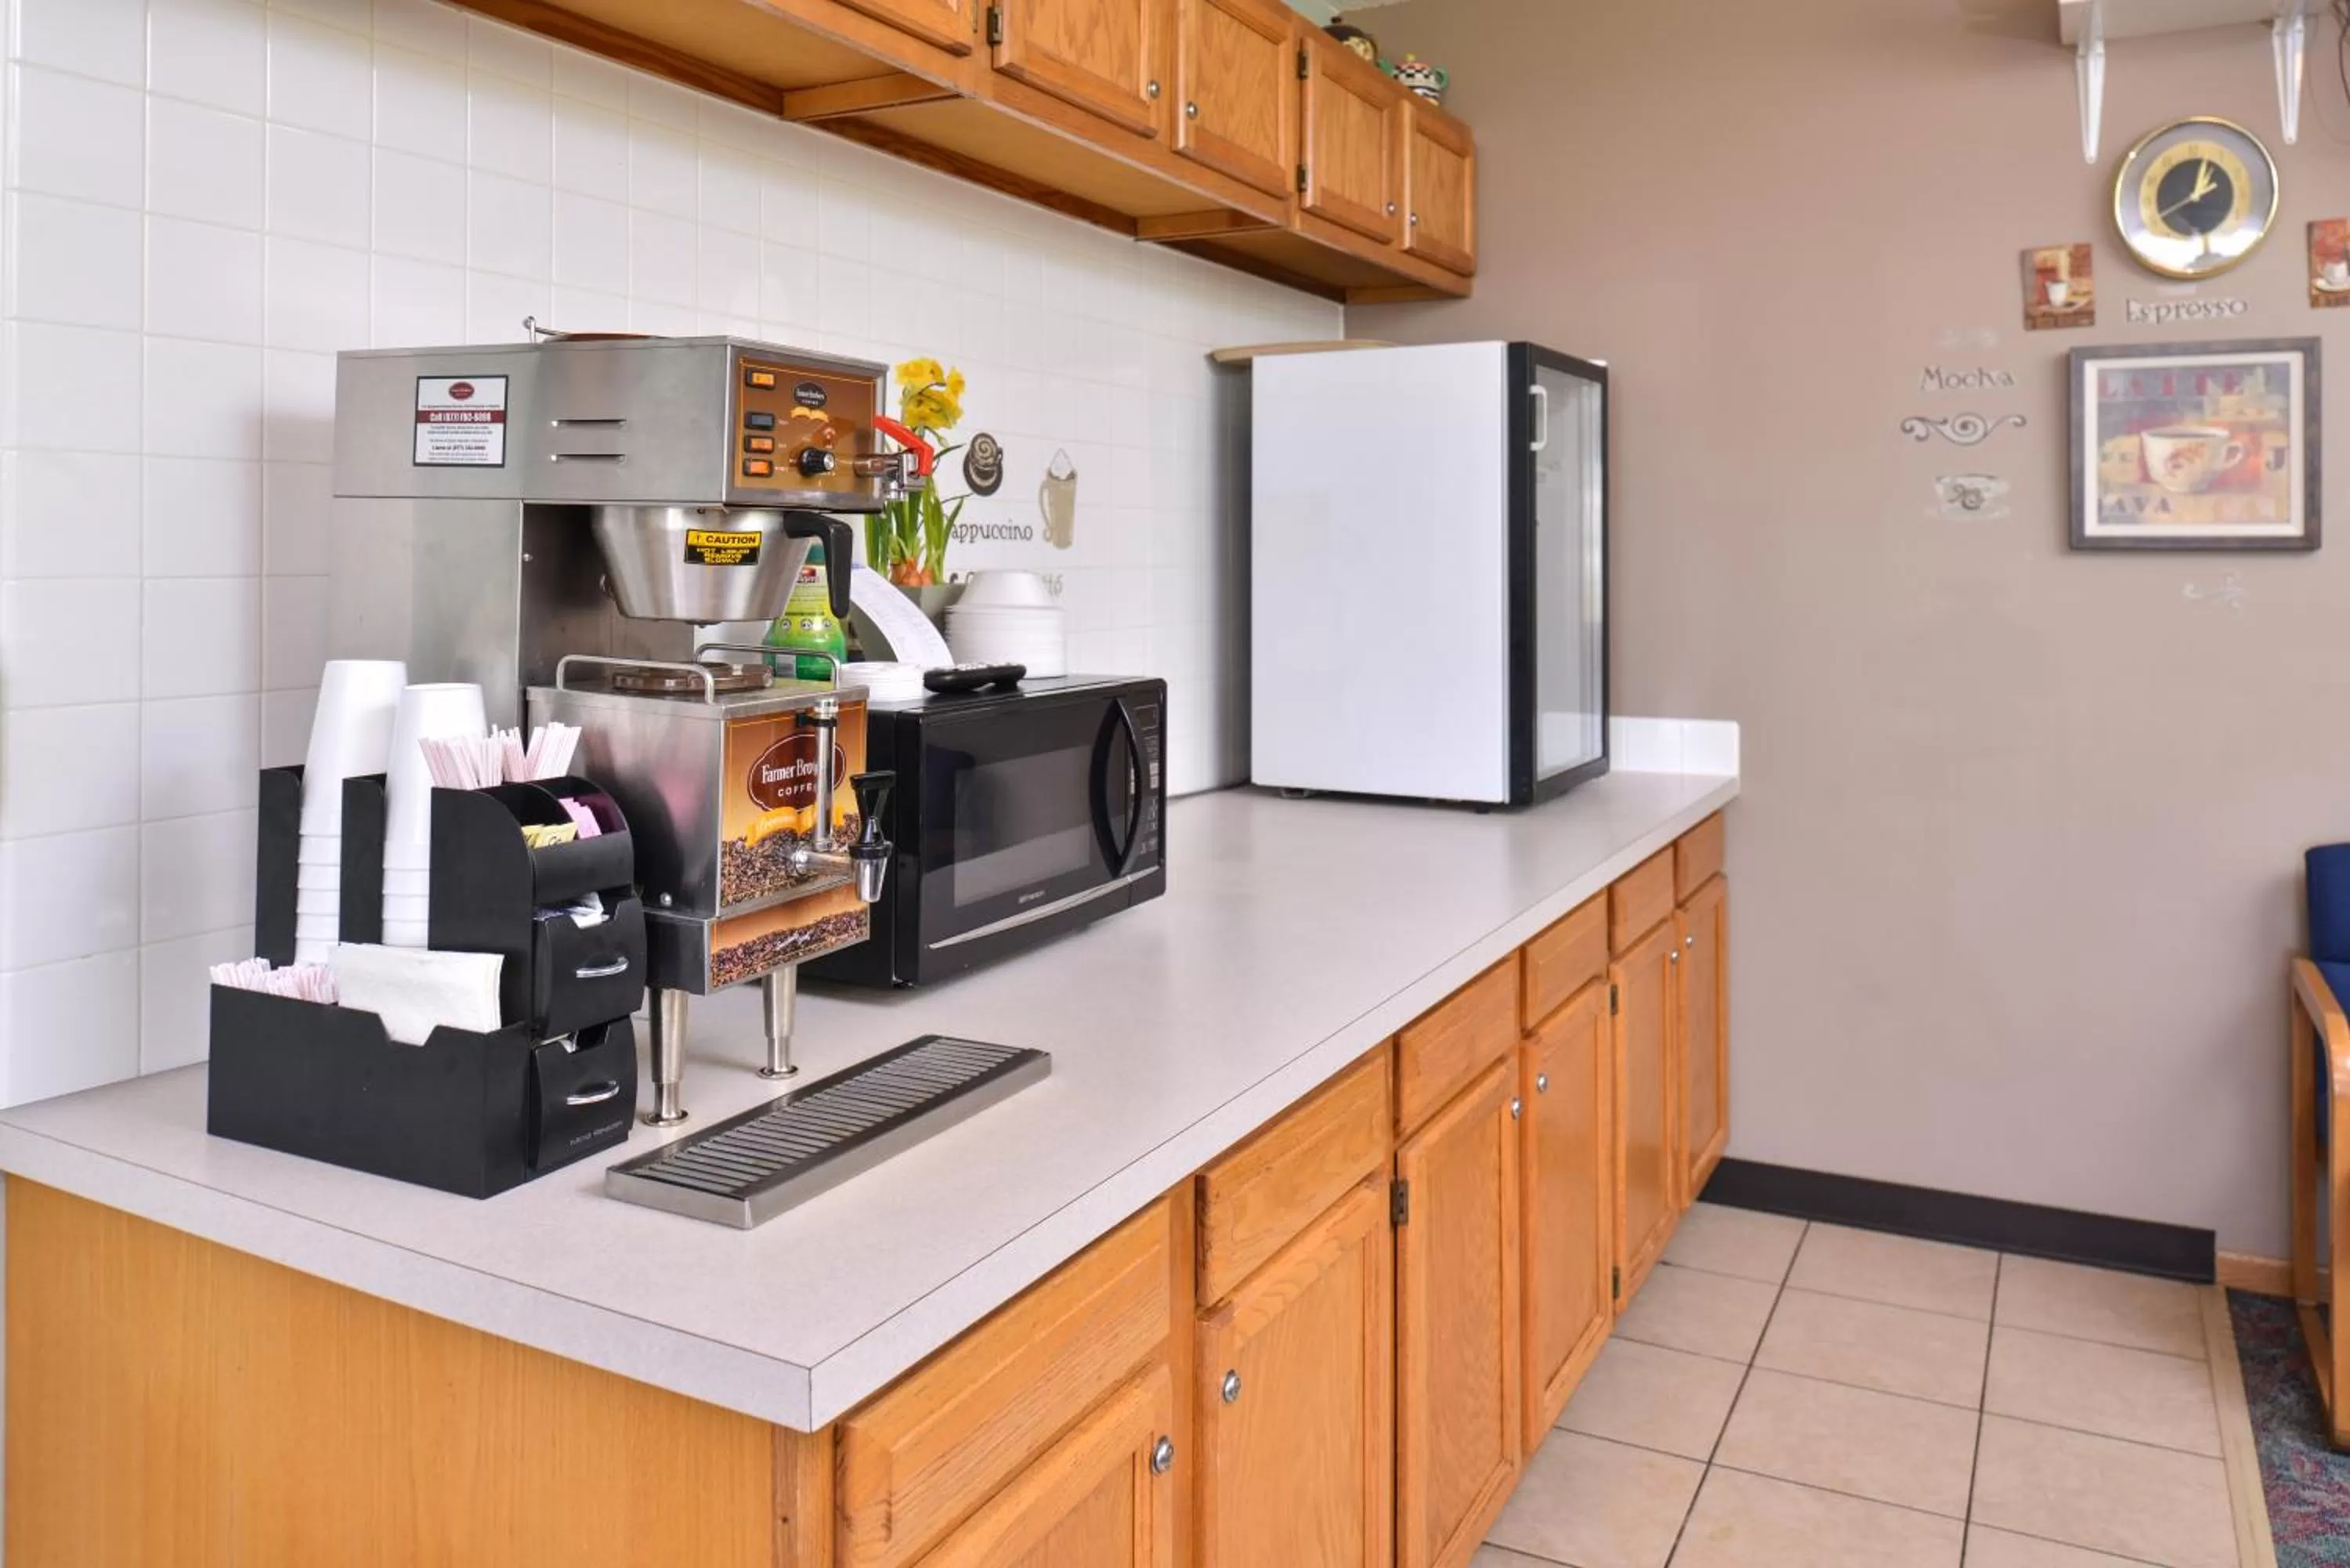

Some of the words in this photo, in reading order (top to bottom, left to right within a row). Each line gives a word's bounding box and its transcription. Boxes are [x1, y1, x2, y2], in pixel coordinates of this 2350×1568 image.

[2125, 297, 2248, 325] Espresso
[1920, 365, 2016, 390] Mocha
[706, 535, 756, 544] CAUTION
[951, 518, 1034, 544] appuccino
[761, 764, 796, 784] Farmer
